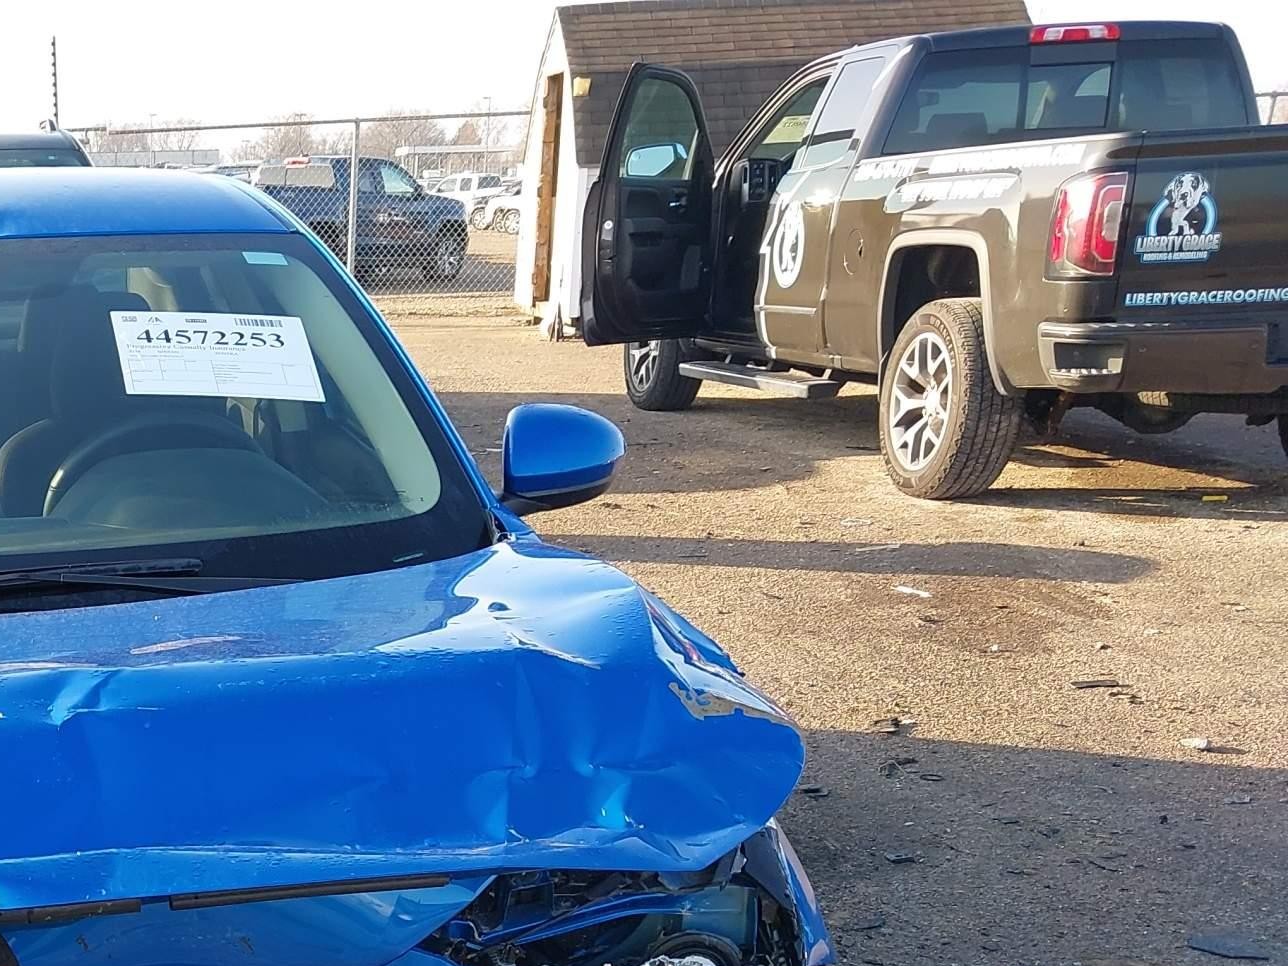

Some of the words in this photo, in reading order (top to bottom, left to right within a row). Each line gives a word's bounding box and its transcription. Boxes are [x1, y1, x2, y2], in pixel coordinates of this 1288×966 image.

[1136, 235, 1183, 252] LIBERTY
[1182, 233, 1221, 250] GRACE
[136, 328, 285, 348] 44572253
